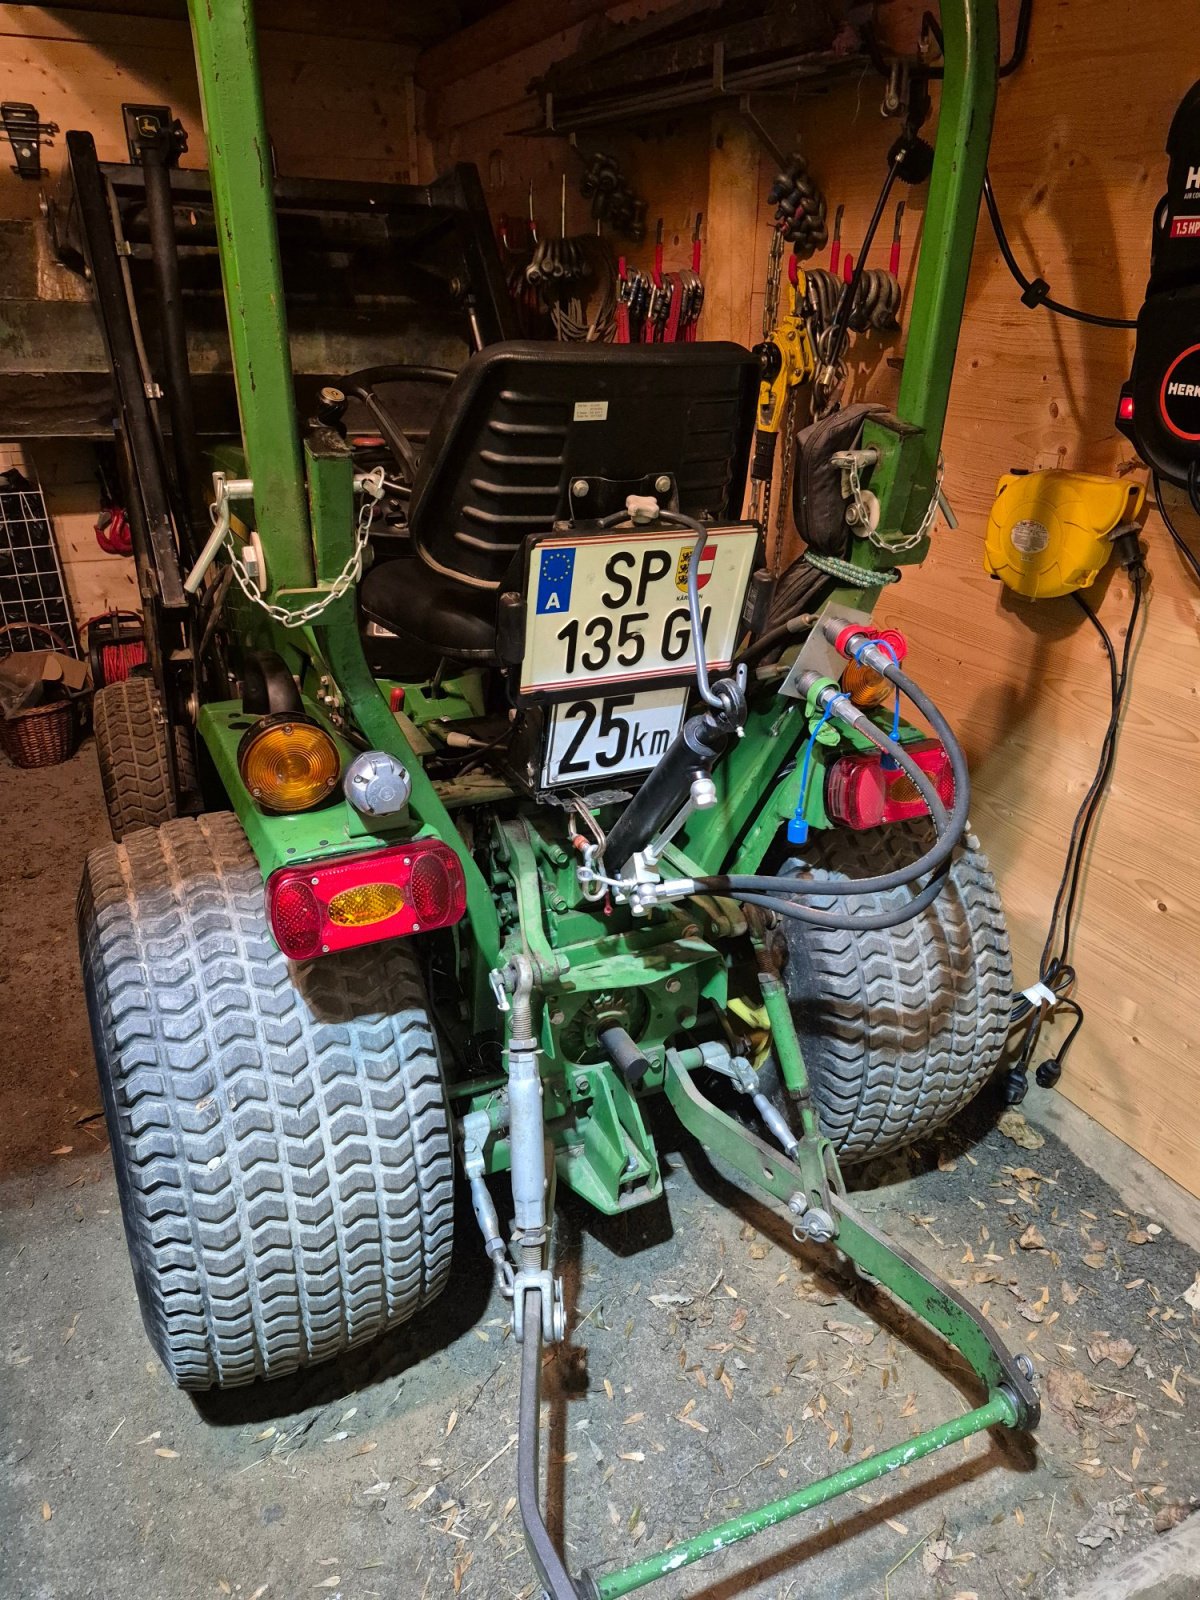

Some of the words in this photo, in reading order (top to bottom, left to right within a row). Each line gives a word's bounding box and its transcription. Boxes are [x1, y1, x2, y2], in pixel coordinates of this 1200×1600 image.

[1176, 222, 1188, 235] 1.5
[1188, 221, 1200, 234] HP
[601, 550, 672, 609] SP
[545, 592, 561, 610] A
[556, 612, 649, 673] 135
